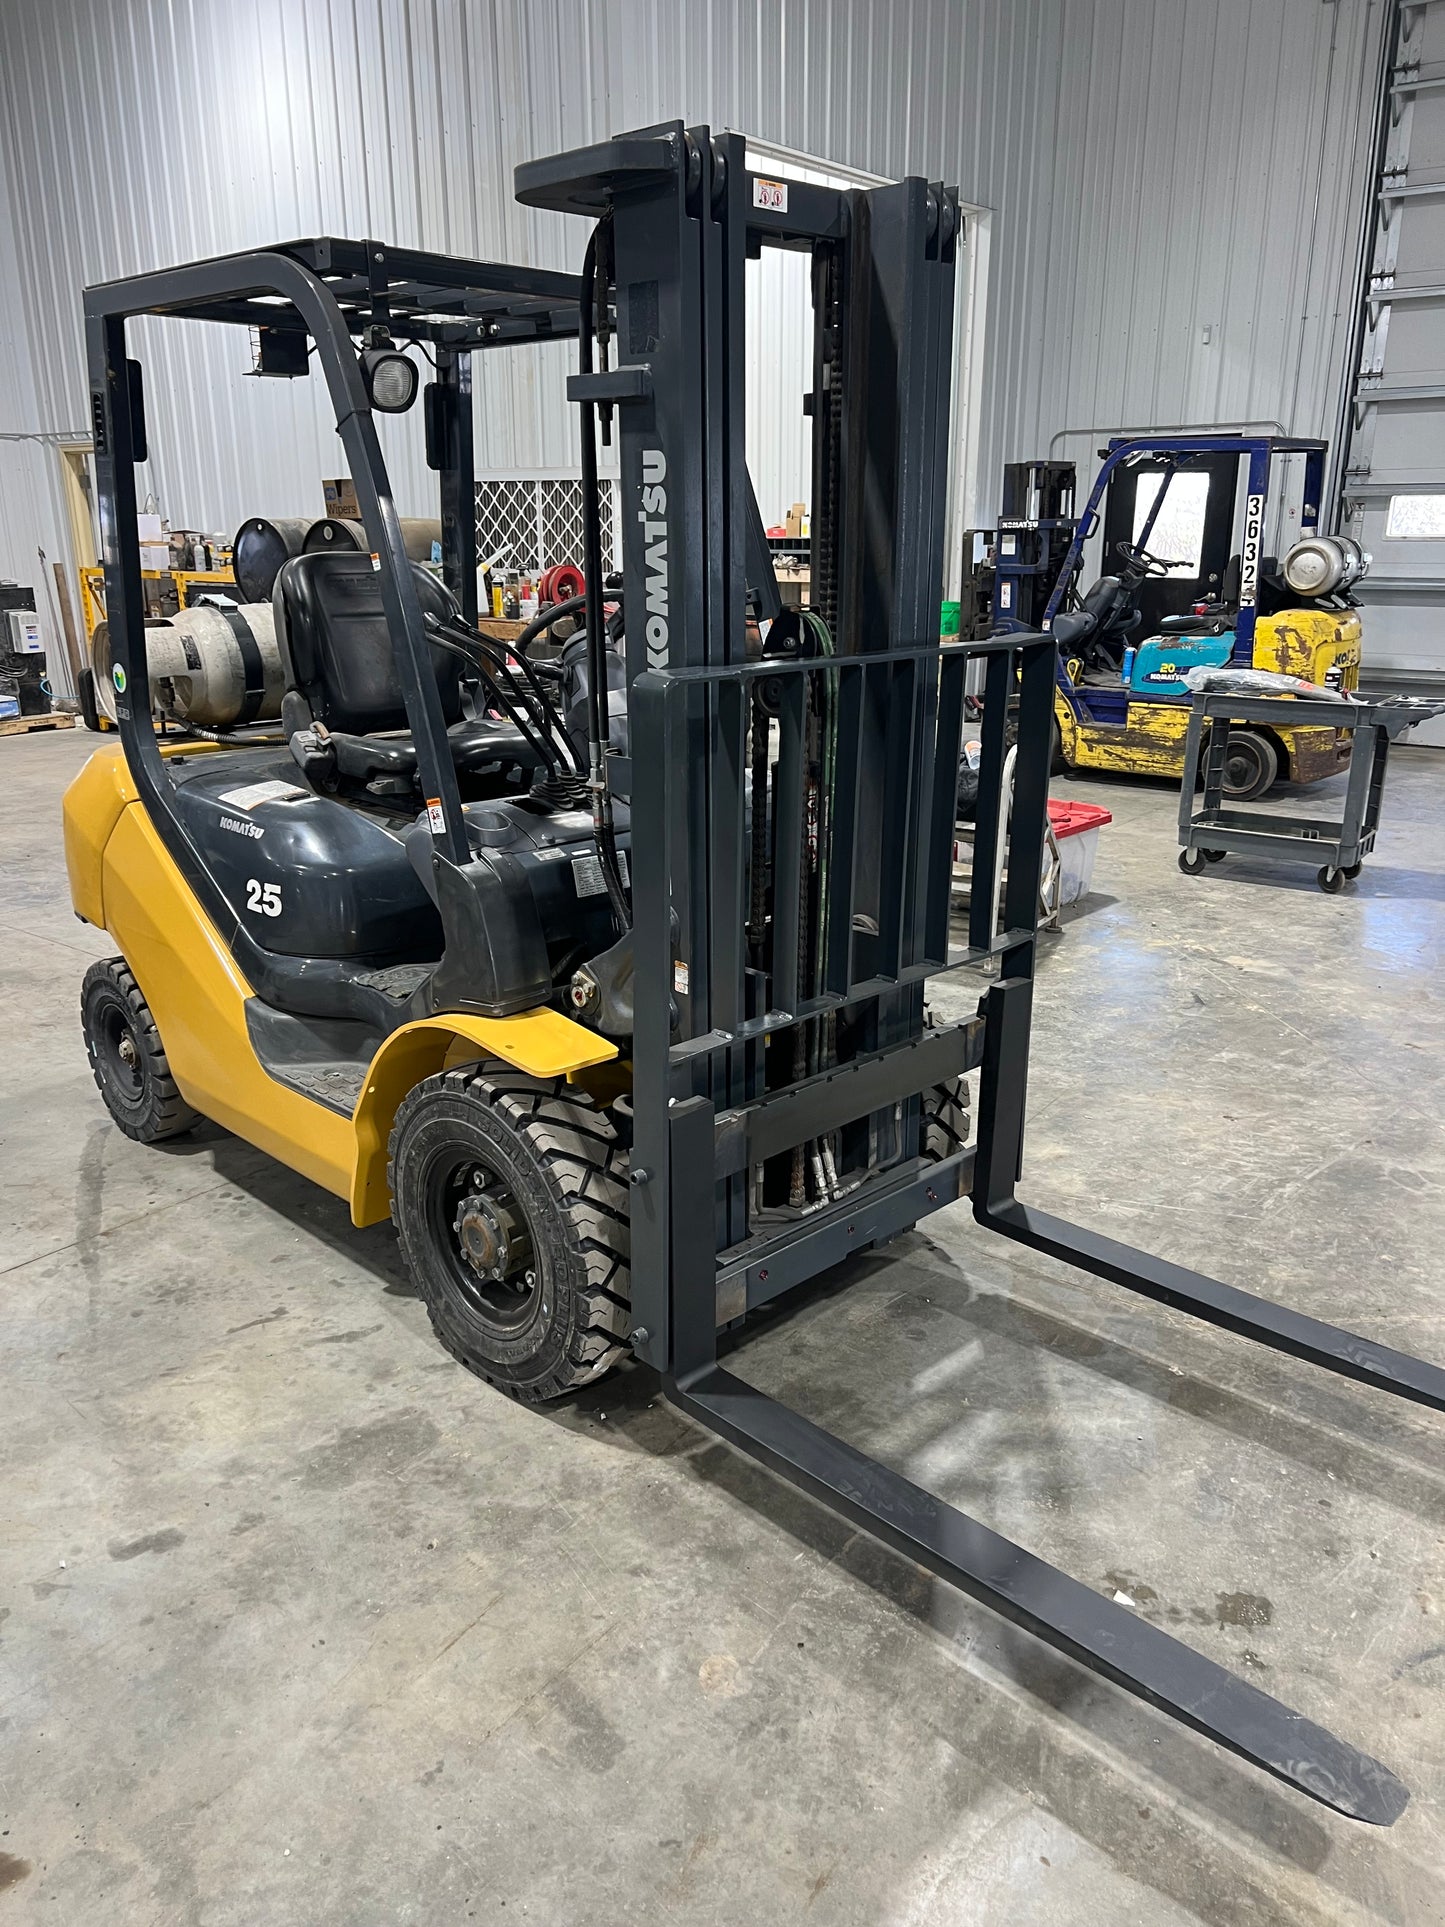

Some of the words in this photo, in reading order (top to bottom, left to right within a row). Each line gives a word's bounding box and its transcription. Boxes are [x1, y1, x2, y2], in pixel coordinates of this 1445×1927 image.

[328, 503, 357, 516] Wipers
[1002, 520, 1039, 529] KOMATSU
[638, 449, 669, 673] KOMATSU
[1160, 663, 1176, 673] 20
[219, 816, 265, 839] KOMATSU
[246, 878, 283, 917] 25
